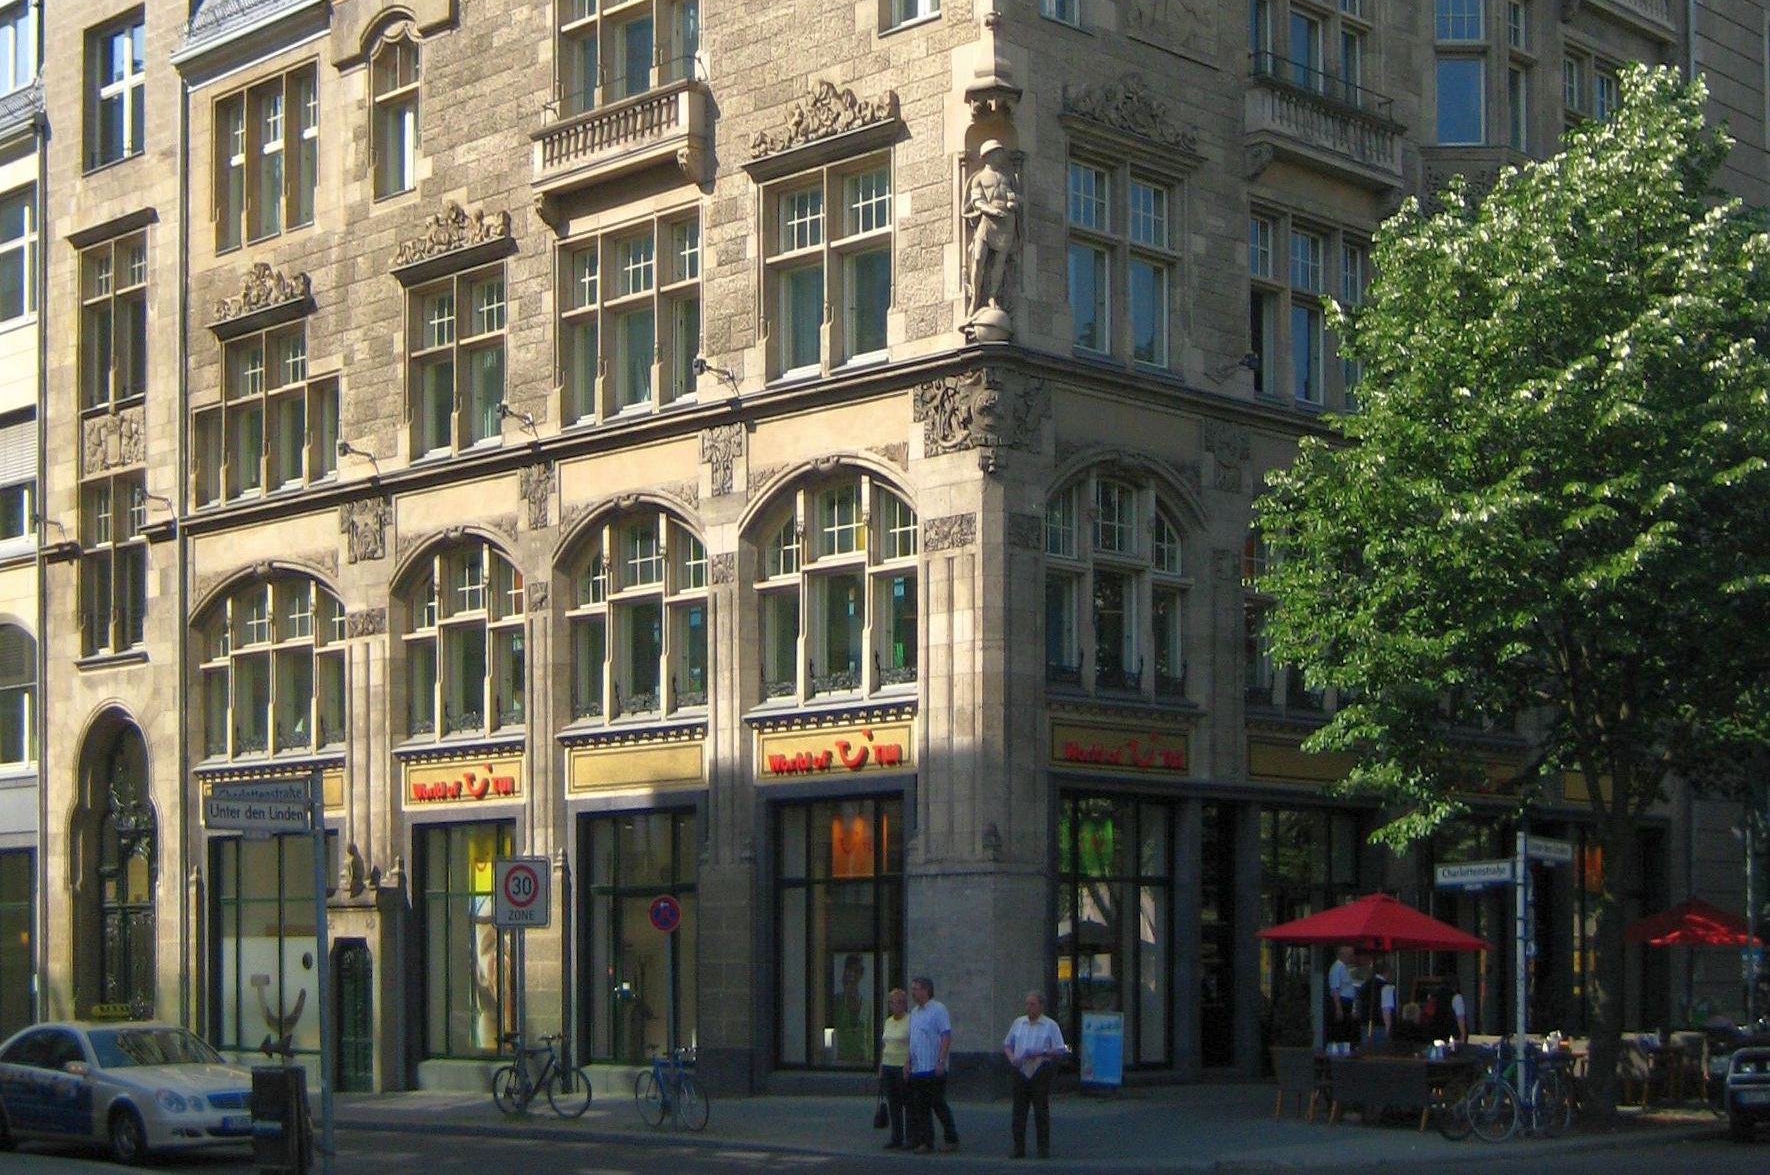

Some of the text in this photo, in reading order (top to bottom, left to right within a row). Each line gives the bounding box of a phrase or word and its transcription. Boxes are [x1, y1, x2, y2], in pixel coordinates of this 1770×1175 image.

[767, 751, 813, 774] World
[814, 749, 832, 772] of
[412, 781, 447, 801] World
[448, 780, 462, 799] of
[210, 803, 303, 821] Unter den Linden
[512, 876, 532, 895] 30
[508, 910, 535, 921] ZONE
